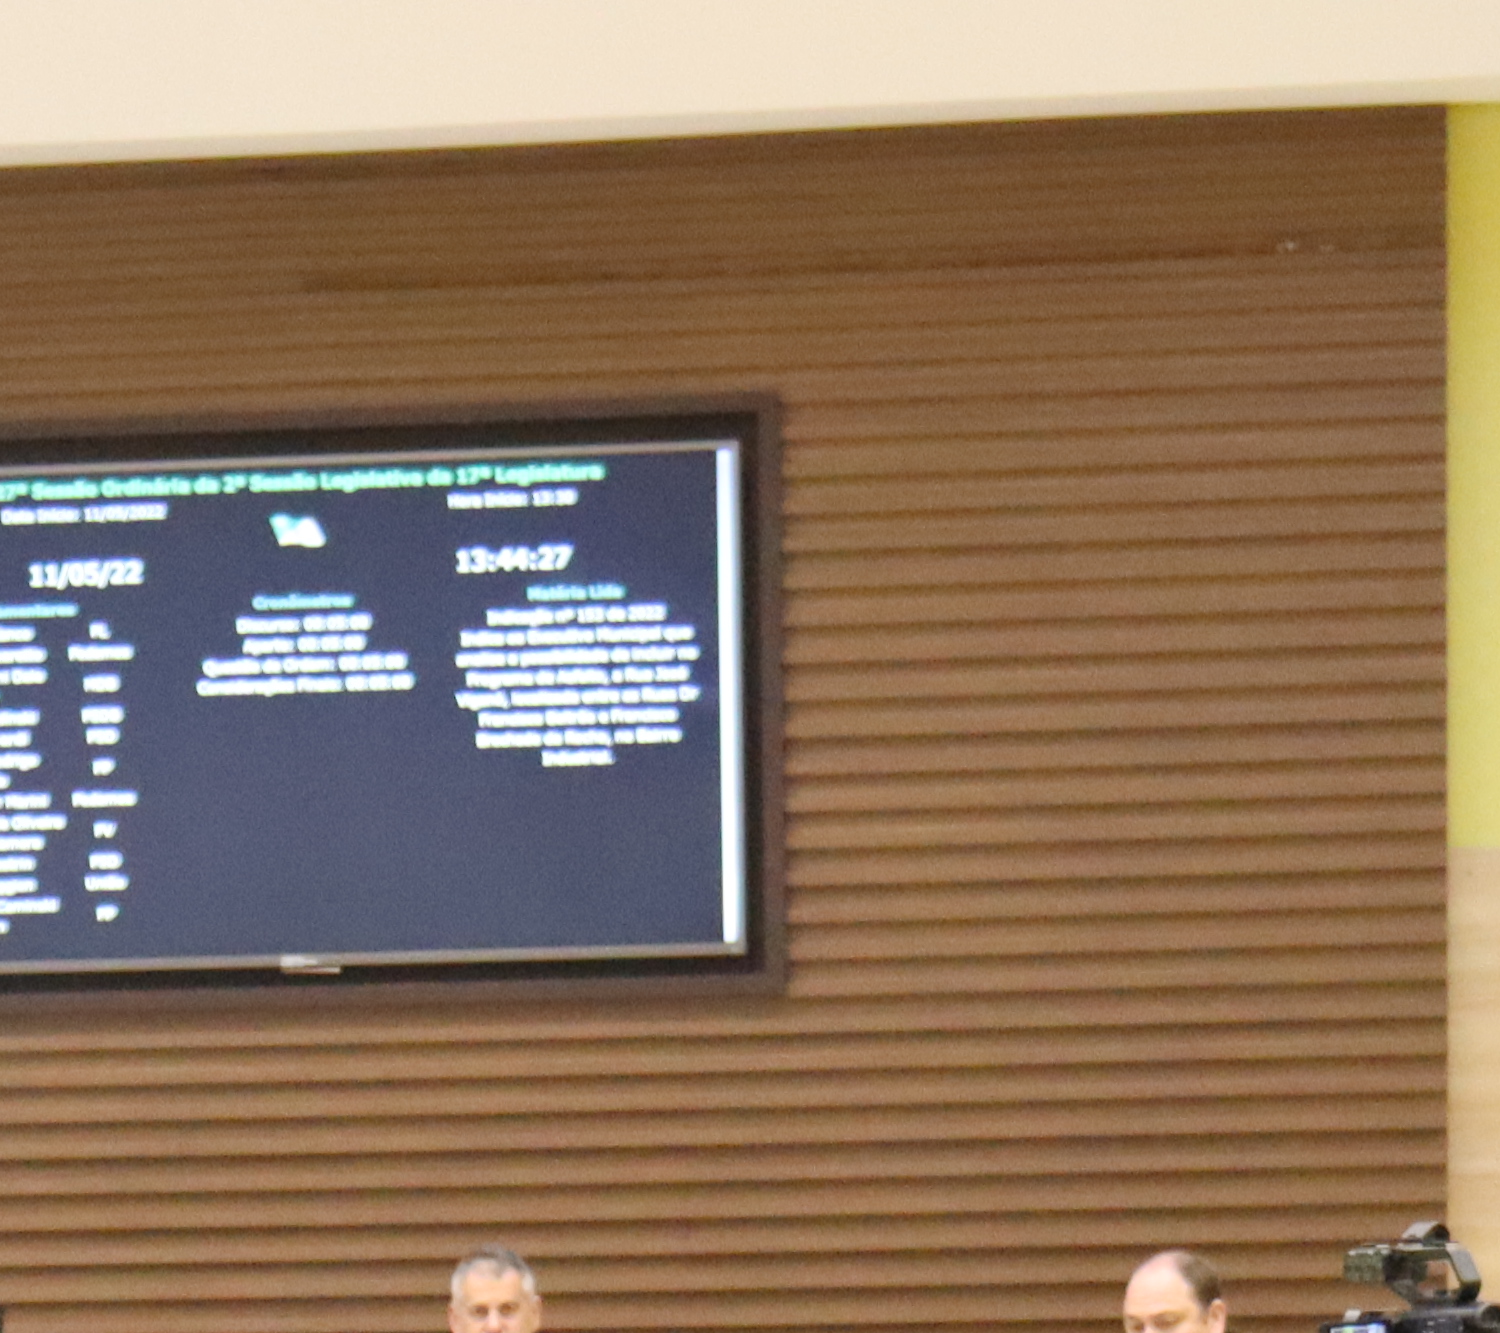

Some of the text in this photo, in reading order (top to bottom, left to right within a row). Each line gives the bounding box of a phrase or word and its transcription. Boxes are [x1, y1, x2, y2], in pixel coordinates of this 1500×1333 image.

[31, 479, 99, 500] Sessão
[101, 477, 192, 497] Ordinária
[194, 476, 220, 494] da
[249, 472, 318, 492] Sessão
[319, 469, 424, 493] Legislativa
[494, 465, 605, 487] Legislatura
[28, 557, 145, 590] 11/05/22
[456, 544, 573, 573] 13:44:27
